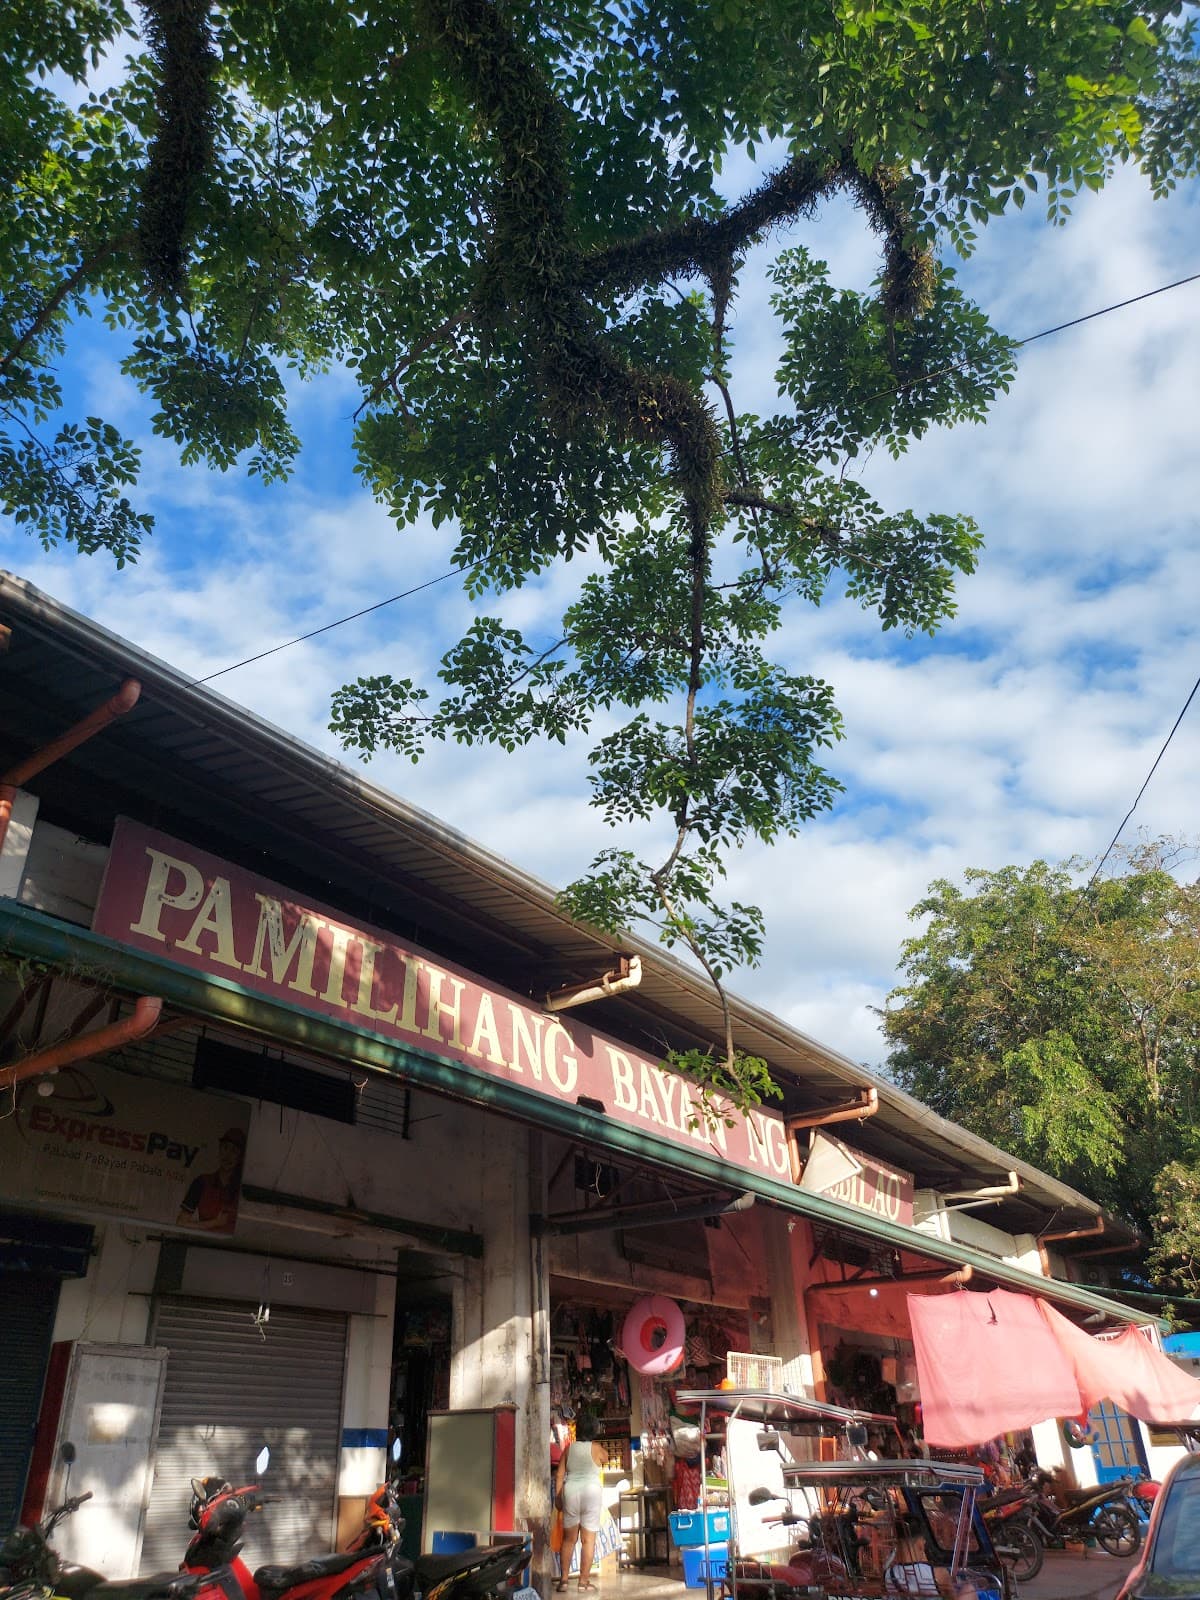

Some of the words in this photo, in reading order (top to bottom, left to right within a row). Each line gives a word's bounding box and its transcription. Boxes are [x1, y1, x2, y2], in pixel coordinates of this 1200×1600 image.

[30, 1105, 199, 1167] ExpressPay
[129, 846, 579, 1093] PAMILIHANG
[605, 1046, 728, 1152] BAYAN
[745, 1109, 789, 1175] NG
[823, 1163, 901, 1221] BILAO
